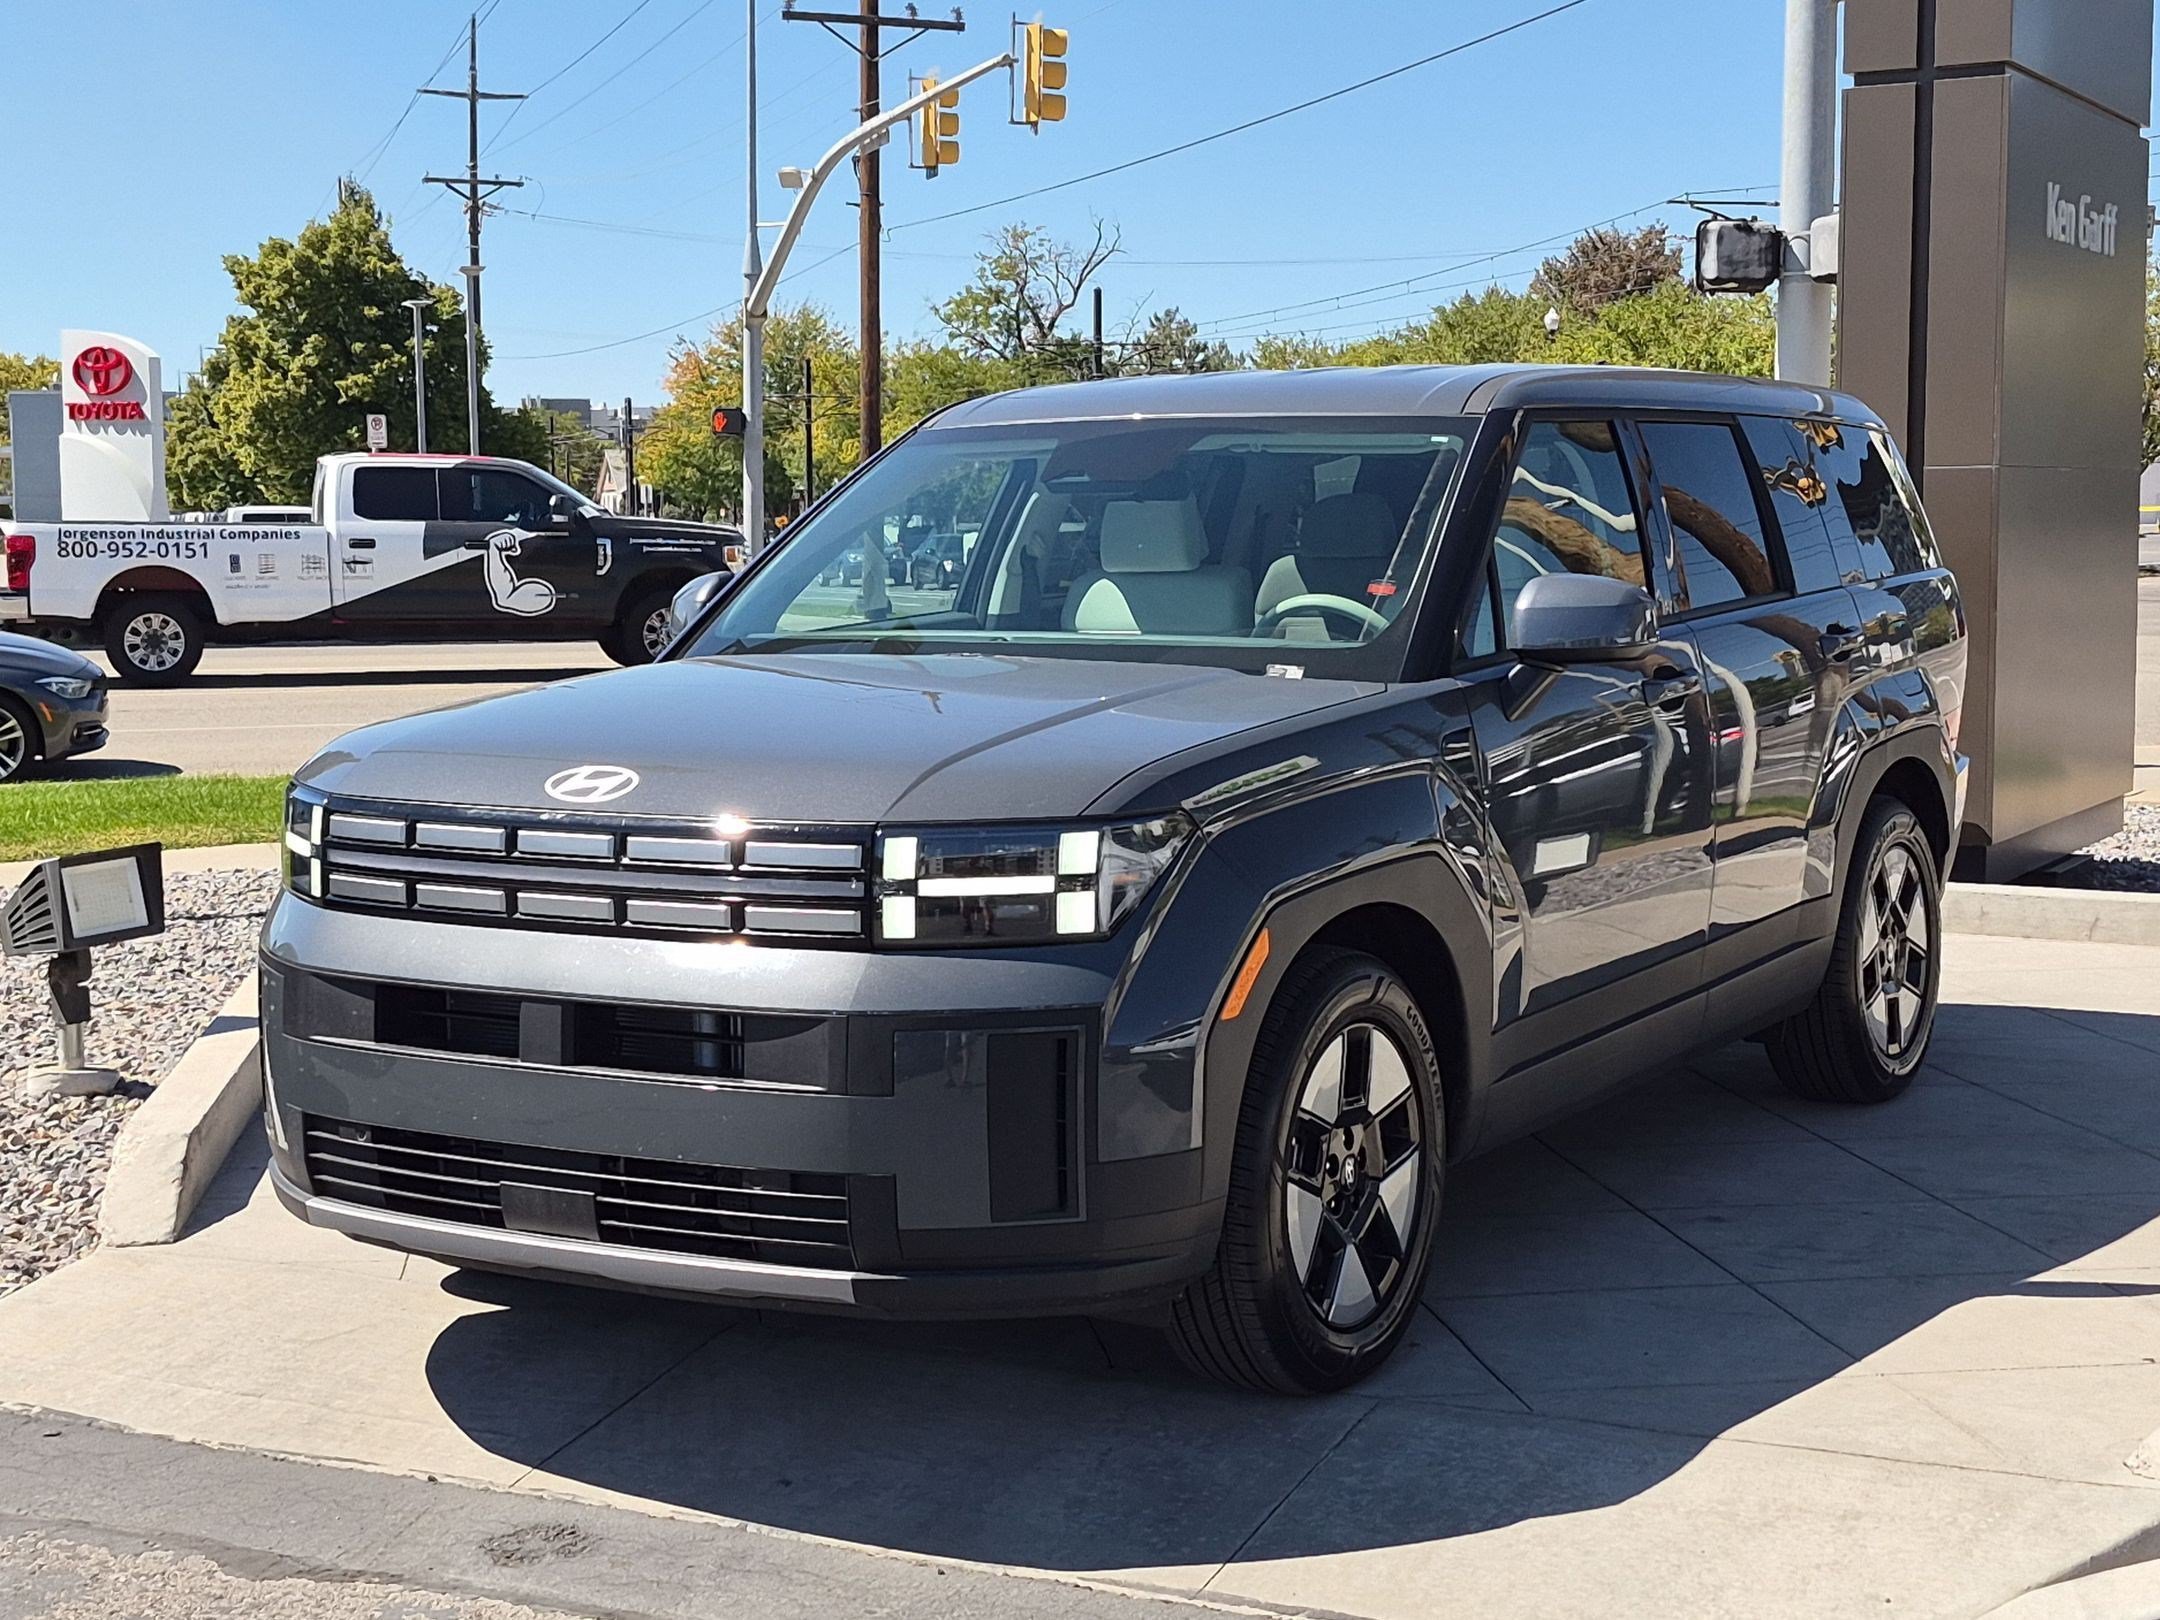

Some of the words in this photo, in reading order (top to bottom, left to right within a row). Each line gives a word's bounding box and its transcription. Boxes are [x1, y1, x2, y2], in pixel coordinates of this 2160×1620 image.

[2046, 181, 2076, 246] Ken
[2079, 194, 2118, 257] Garff
[64, 402, 145, 421] TOYOTA
[57, 527, 137, 542] Jorgenson
[141, 527, 215, 540] Industrial
[219, 527, 301, 543] Companies
[57, 541, 208, 558] 800-952-0151
